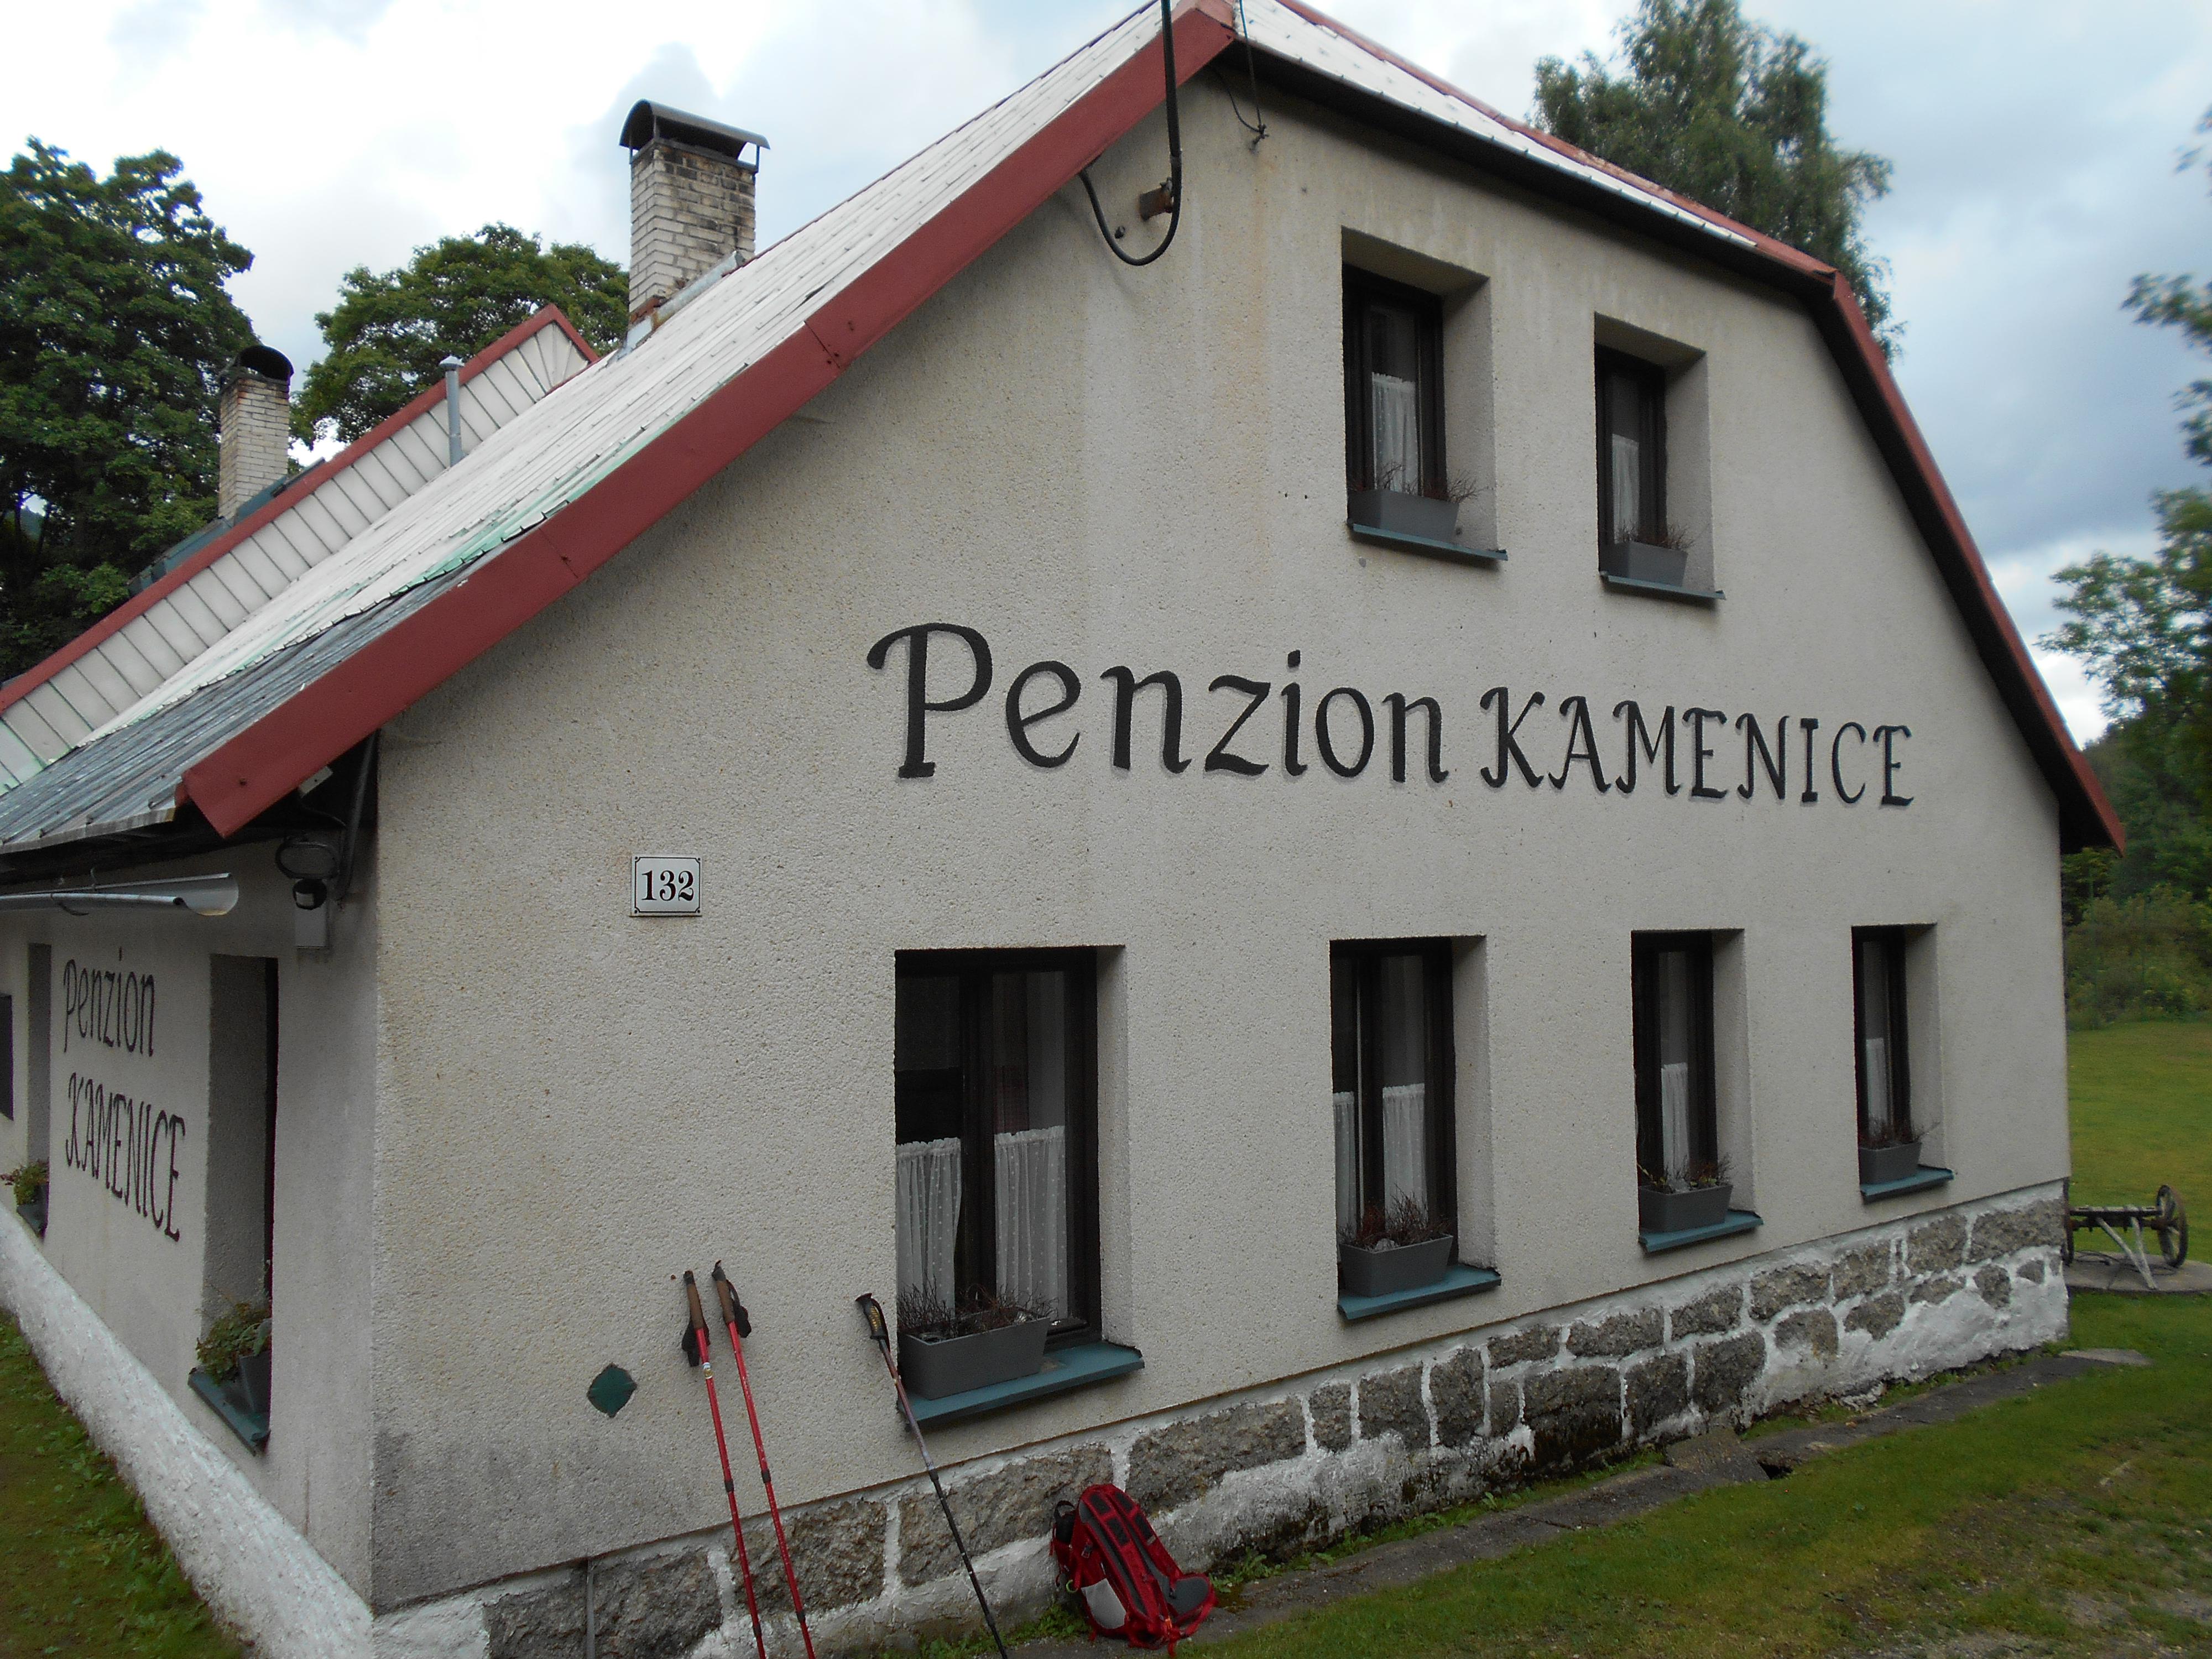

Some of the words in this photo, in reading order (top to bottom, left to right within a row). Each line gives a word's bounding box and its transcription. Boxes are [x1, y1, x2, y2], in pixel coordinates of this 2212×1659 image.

[867, 622, 1449, 783] Penzion
[1479, 686, 1914, 806] KAMENICE
[641, 870, 695, 901] 132
[66, 1072, 186, 1242] KAMENICE
